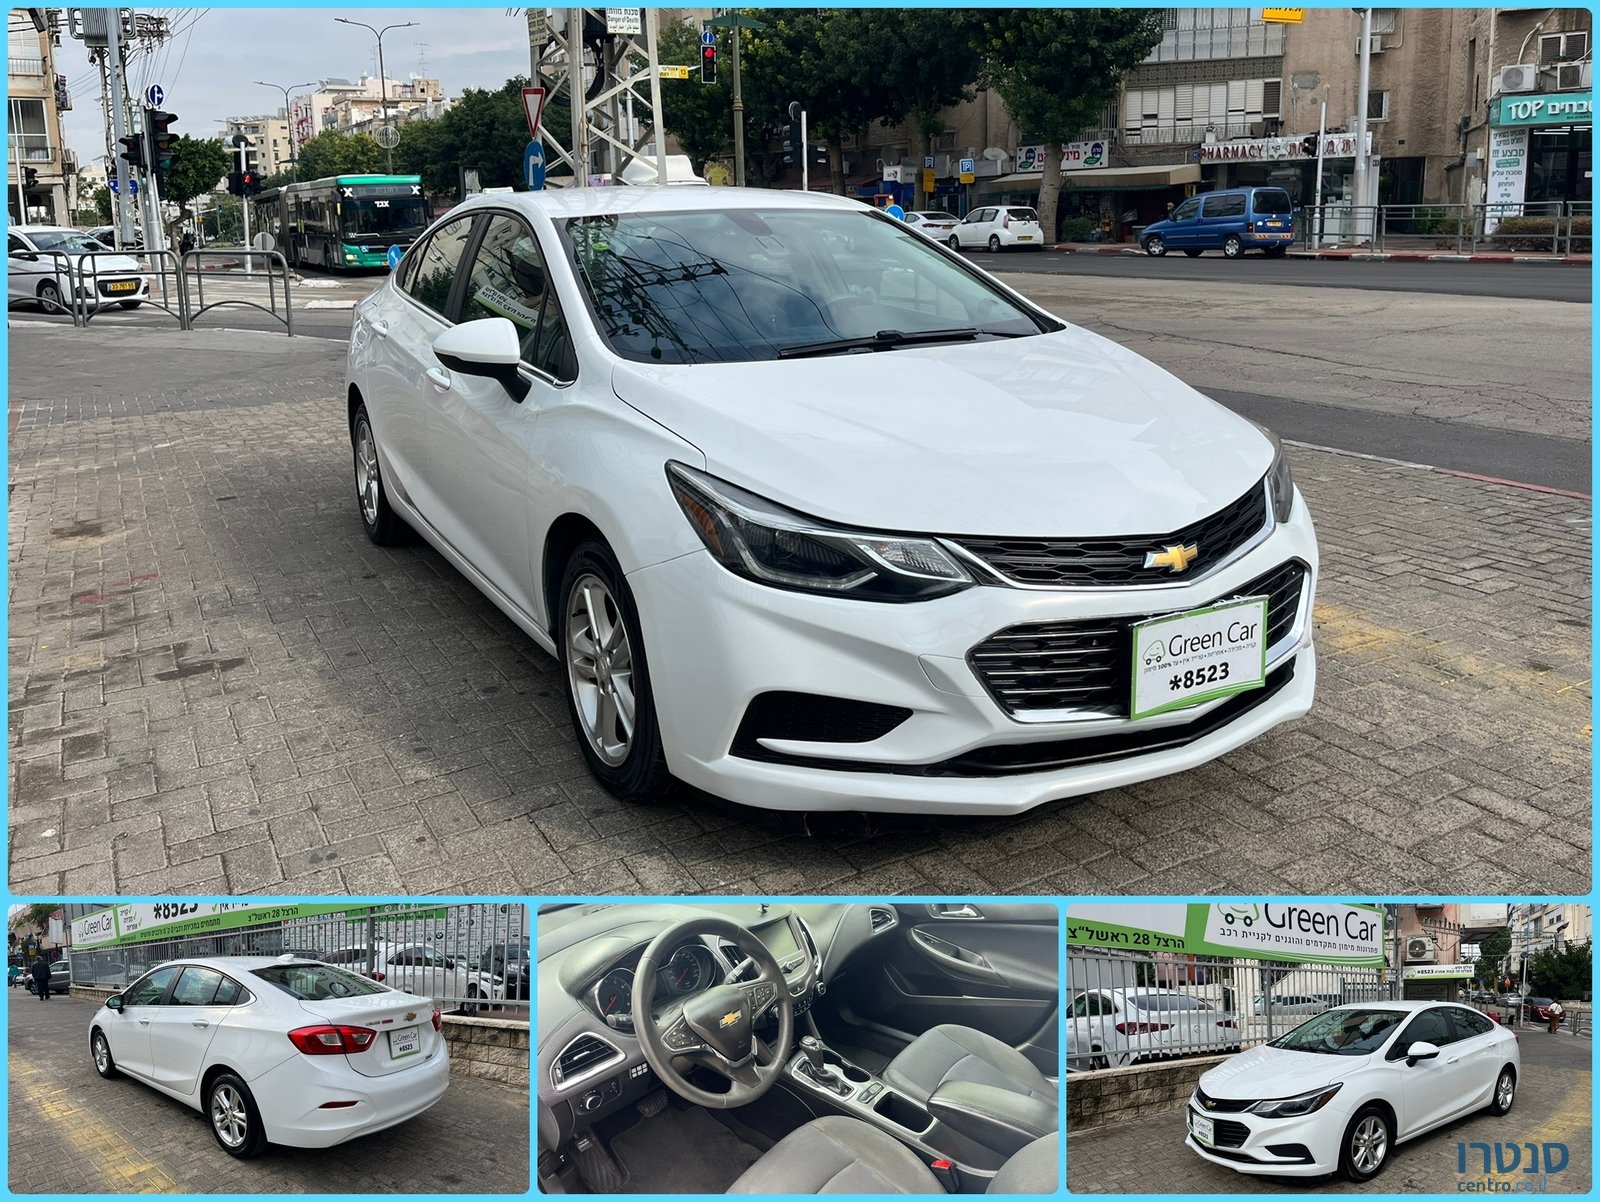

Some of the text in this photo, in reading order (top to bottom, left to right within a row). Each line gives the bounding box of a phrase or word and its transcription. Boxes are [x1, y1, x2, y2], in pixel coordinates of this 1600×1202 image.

[608, 15, 622, 24] Danger
[1508, 100, 1545, 120] TOP
[1200, 144, 1264, 160] PHARMACY
[1502, 148, 1525, 158] מבצע
[374, 200, 390, 208] אגד
[1168, 622, 1258, 657] Green Car
[1158, 662, 1172, 670] 100%
[271, 909, 280, 918] 28
[281, 907, 298, 917] הרצל
[84, 914, 112, 935] Green Car
[1264, 903, 1376, 942] Green Car
[1132, 932, 1150, 945] 28
[1154, 934, 1184, 948] הרצל
[1220, 928, 1378, 954] פתרונות מימון מתקדמים והוגנים לקניית רכב
